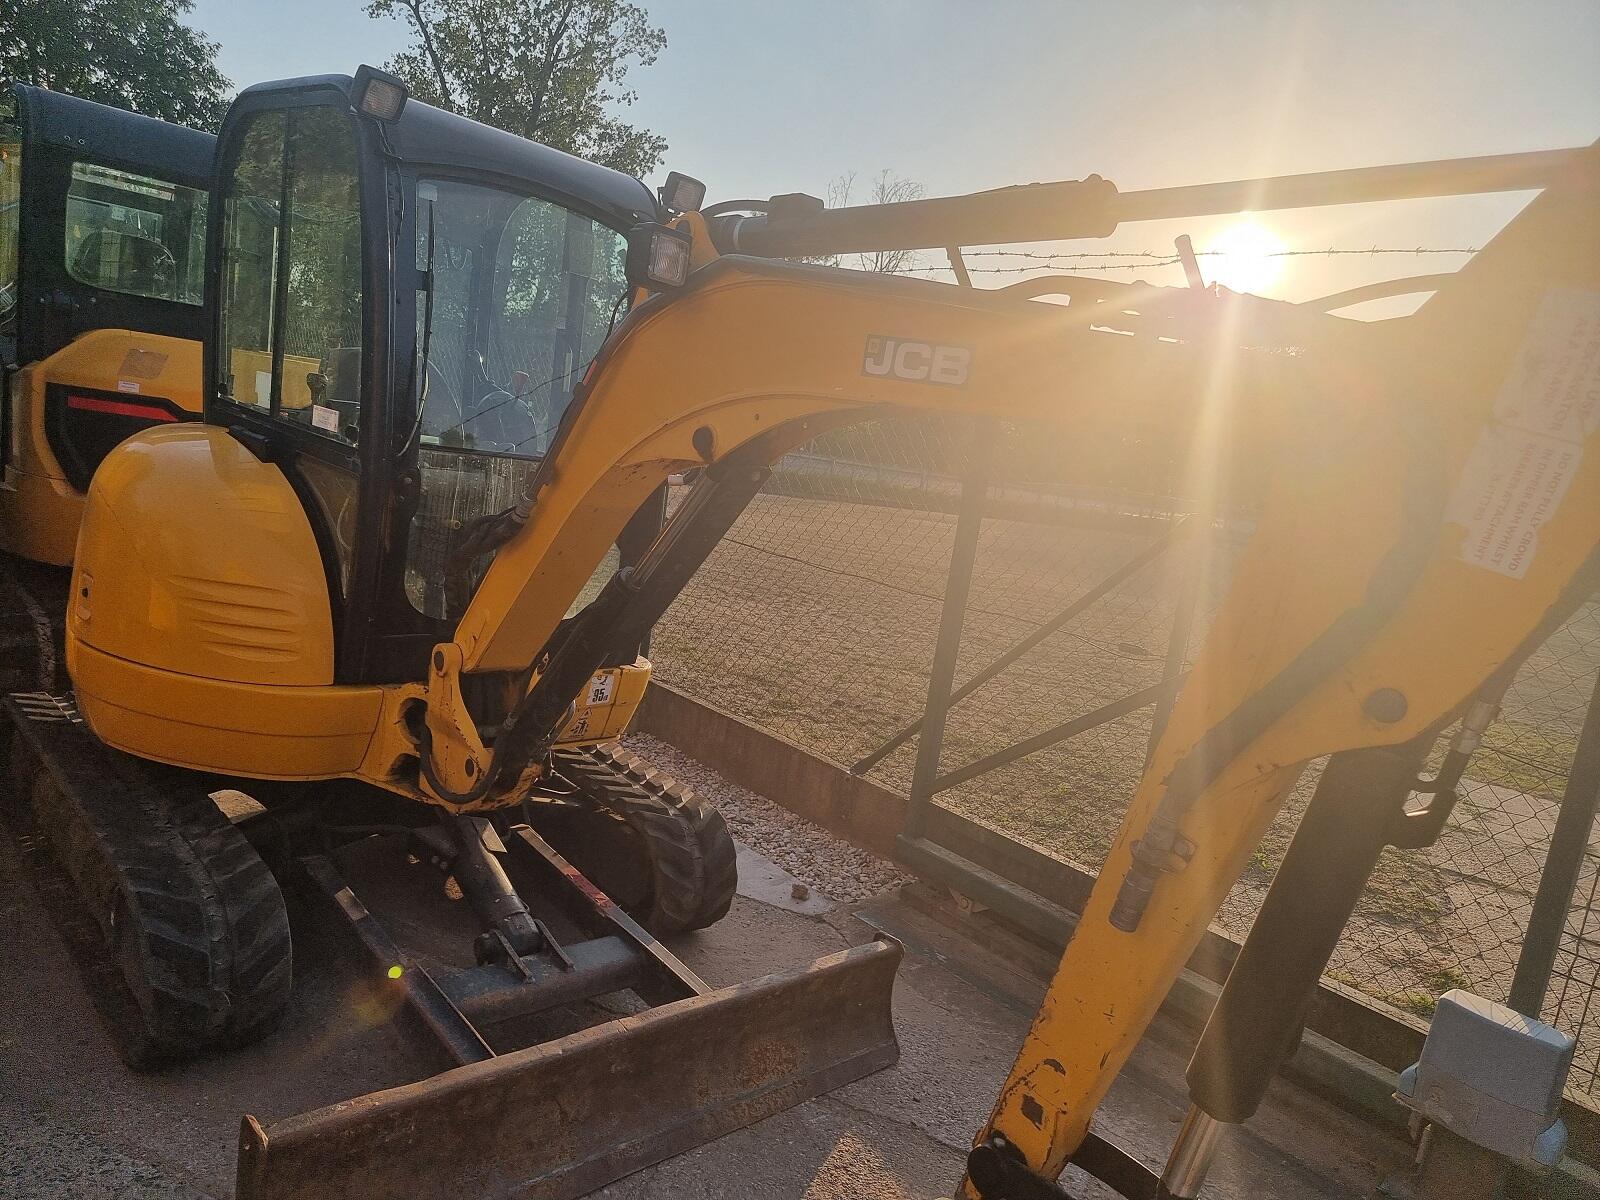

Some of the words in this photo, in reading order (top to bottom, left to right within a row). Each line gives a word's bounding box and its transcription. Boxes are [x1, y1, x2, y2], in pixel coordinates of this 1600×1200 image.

[865, 341, 970, 385] JCB
[1541, 448, 1554, 460] IN
[1555, 452, 1572, 470] DO
[1544, 471, 1563, 495] NOT
[1471, 489, 1515, 560] ATTACHMENT
[1510, 501, 1529, 524] RAM
[1527, 497, 1551, 529] FULLY
[1489, 524, 1518, 566] WHILST
[1506, 530, 1534, 571] CROWD
